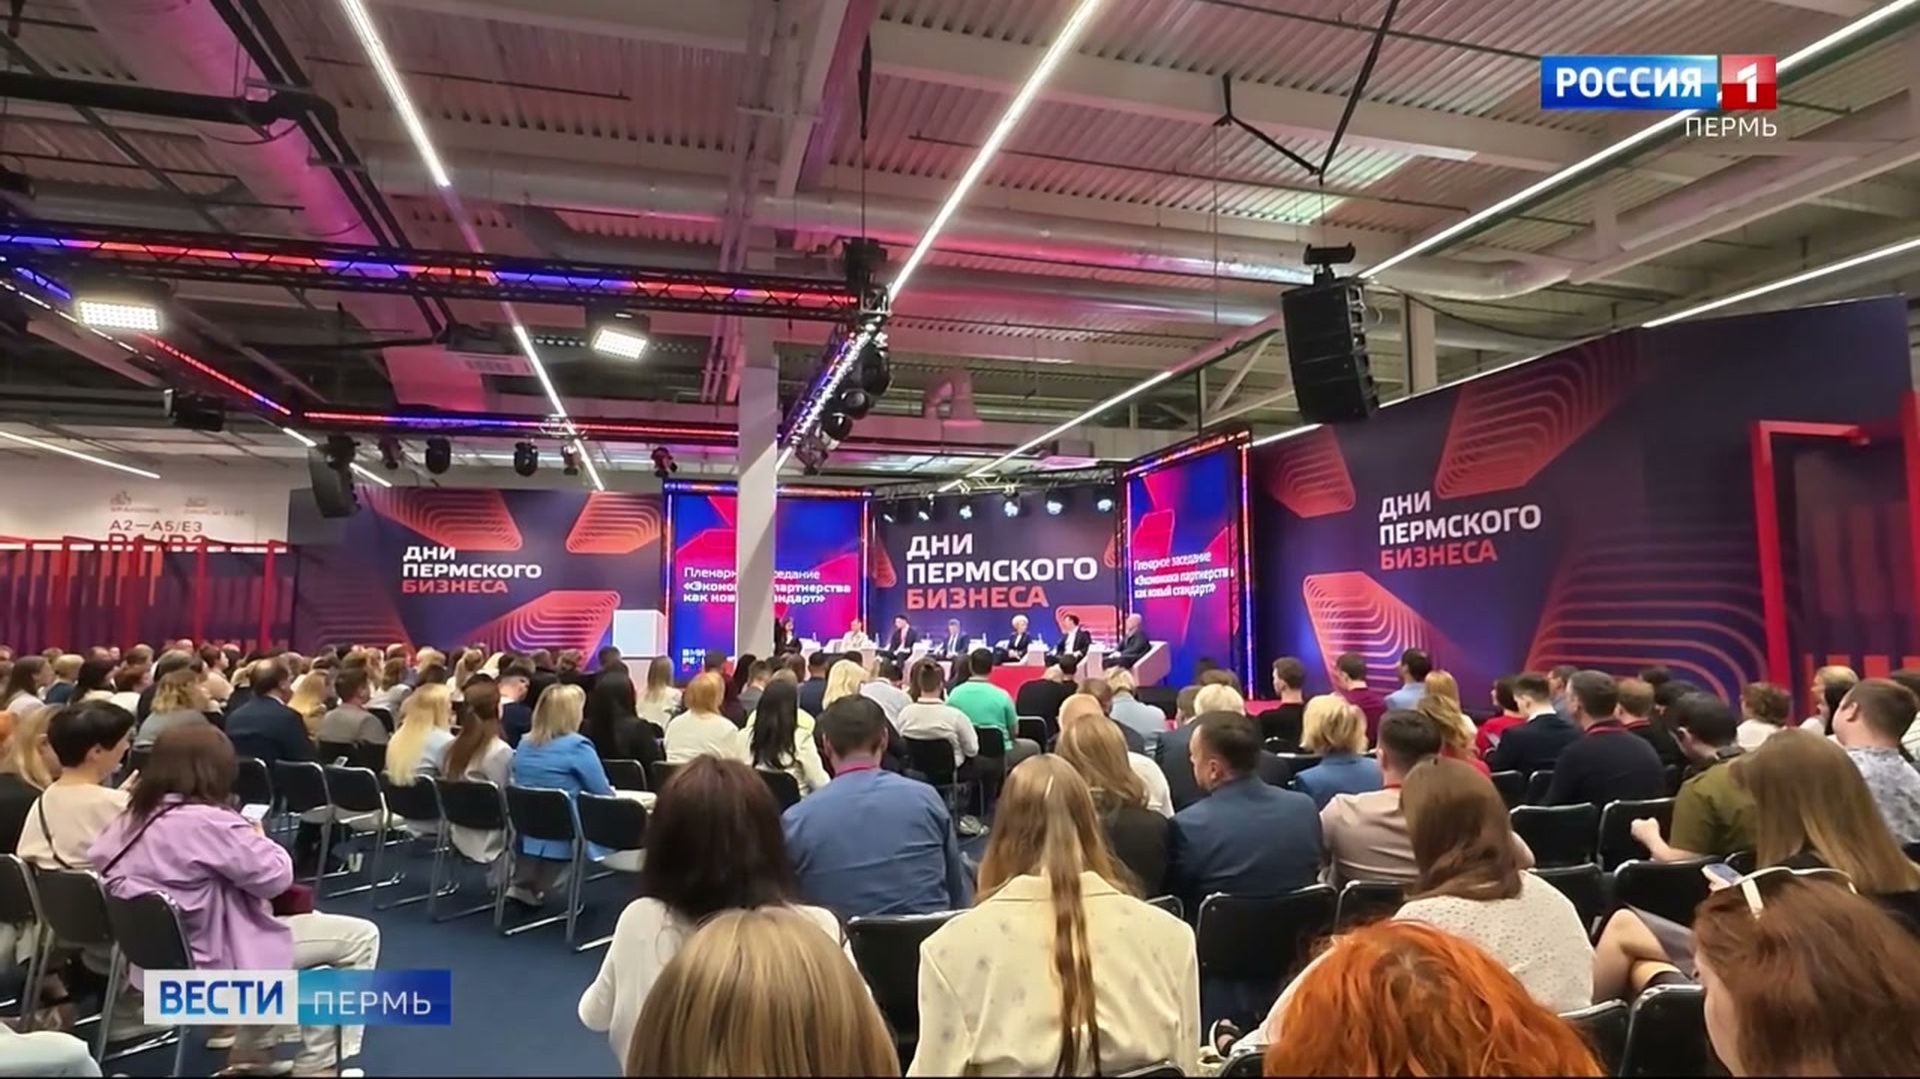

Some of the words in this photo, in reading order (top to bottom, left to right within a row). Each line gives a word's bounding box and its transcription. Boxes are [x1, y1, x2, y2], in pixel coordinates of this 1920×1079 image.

[1379, 490, 1431, 523] ДНИ
[1379, 504, 1542, 546] ПЕРМСКОГО
[402, 546, 456, 562] ДНИ
[906, 533, 973, 561] ДНИ
[1380, 539, 1498, 571] БИЗНЕСА
[402, 563, 542, 578] ПЕРМСКОГО
[684, 567, 737, 579] Пленарн
[906, 557, 1098, 585] ПЕРМСКОГО
[402, 580, 508, 593] БИЗНЕСА
[683, 593, 709, 603] как
[711, 593, 736, 603] нов
[906, 585, 1049, 610] БИЗНЕСА
